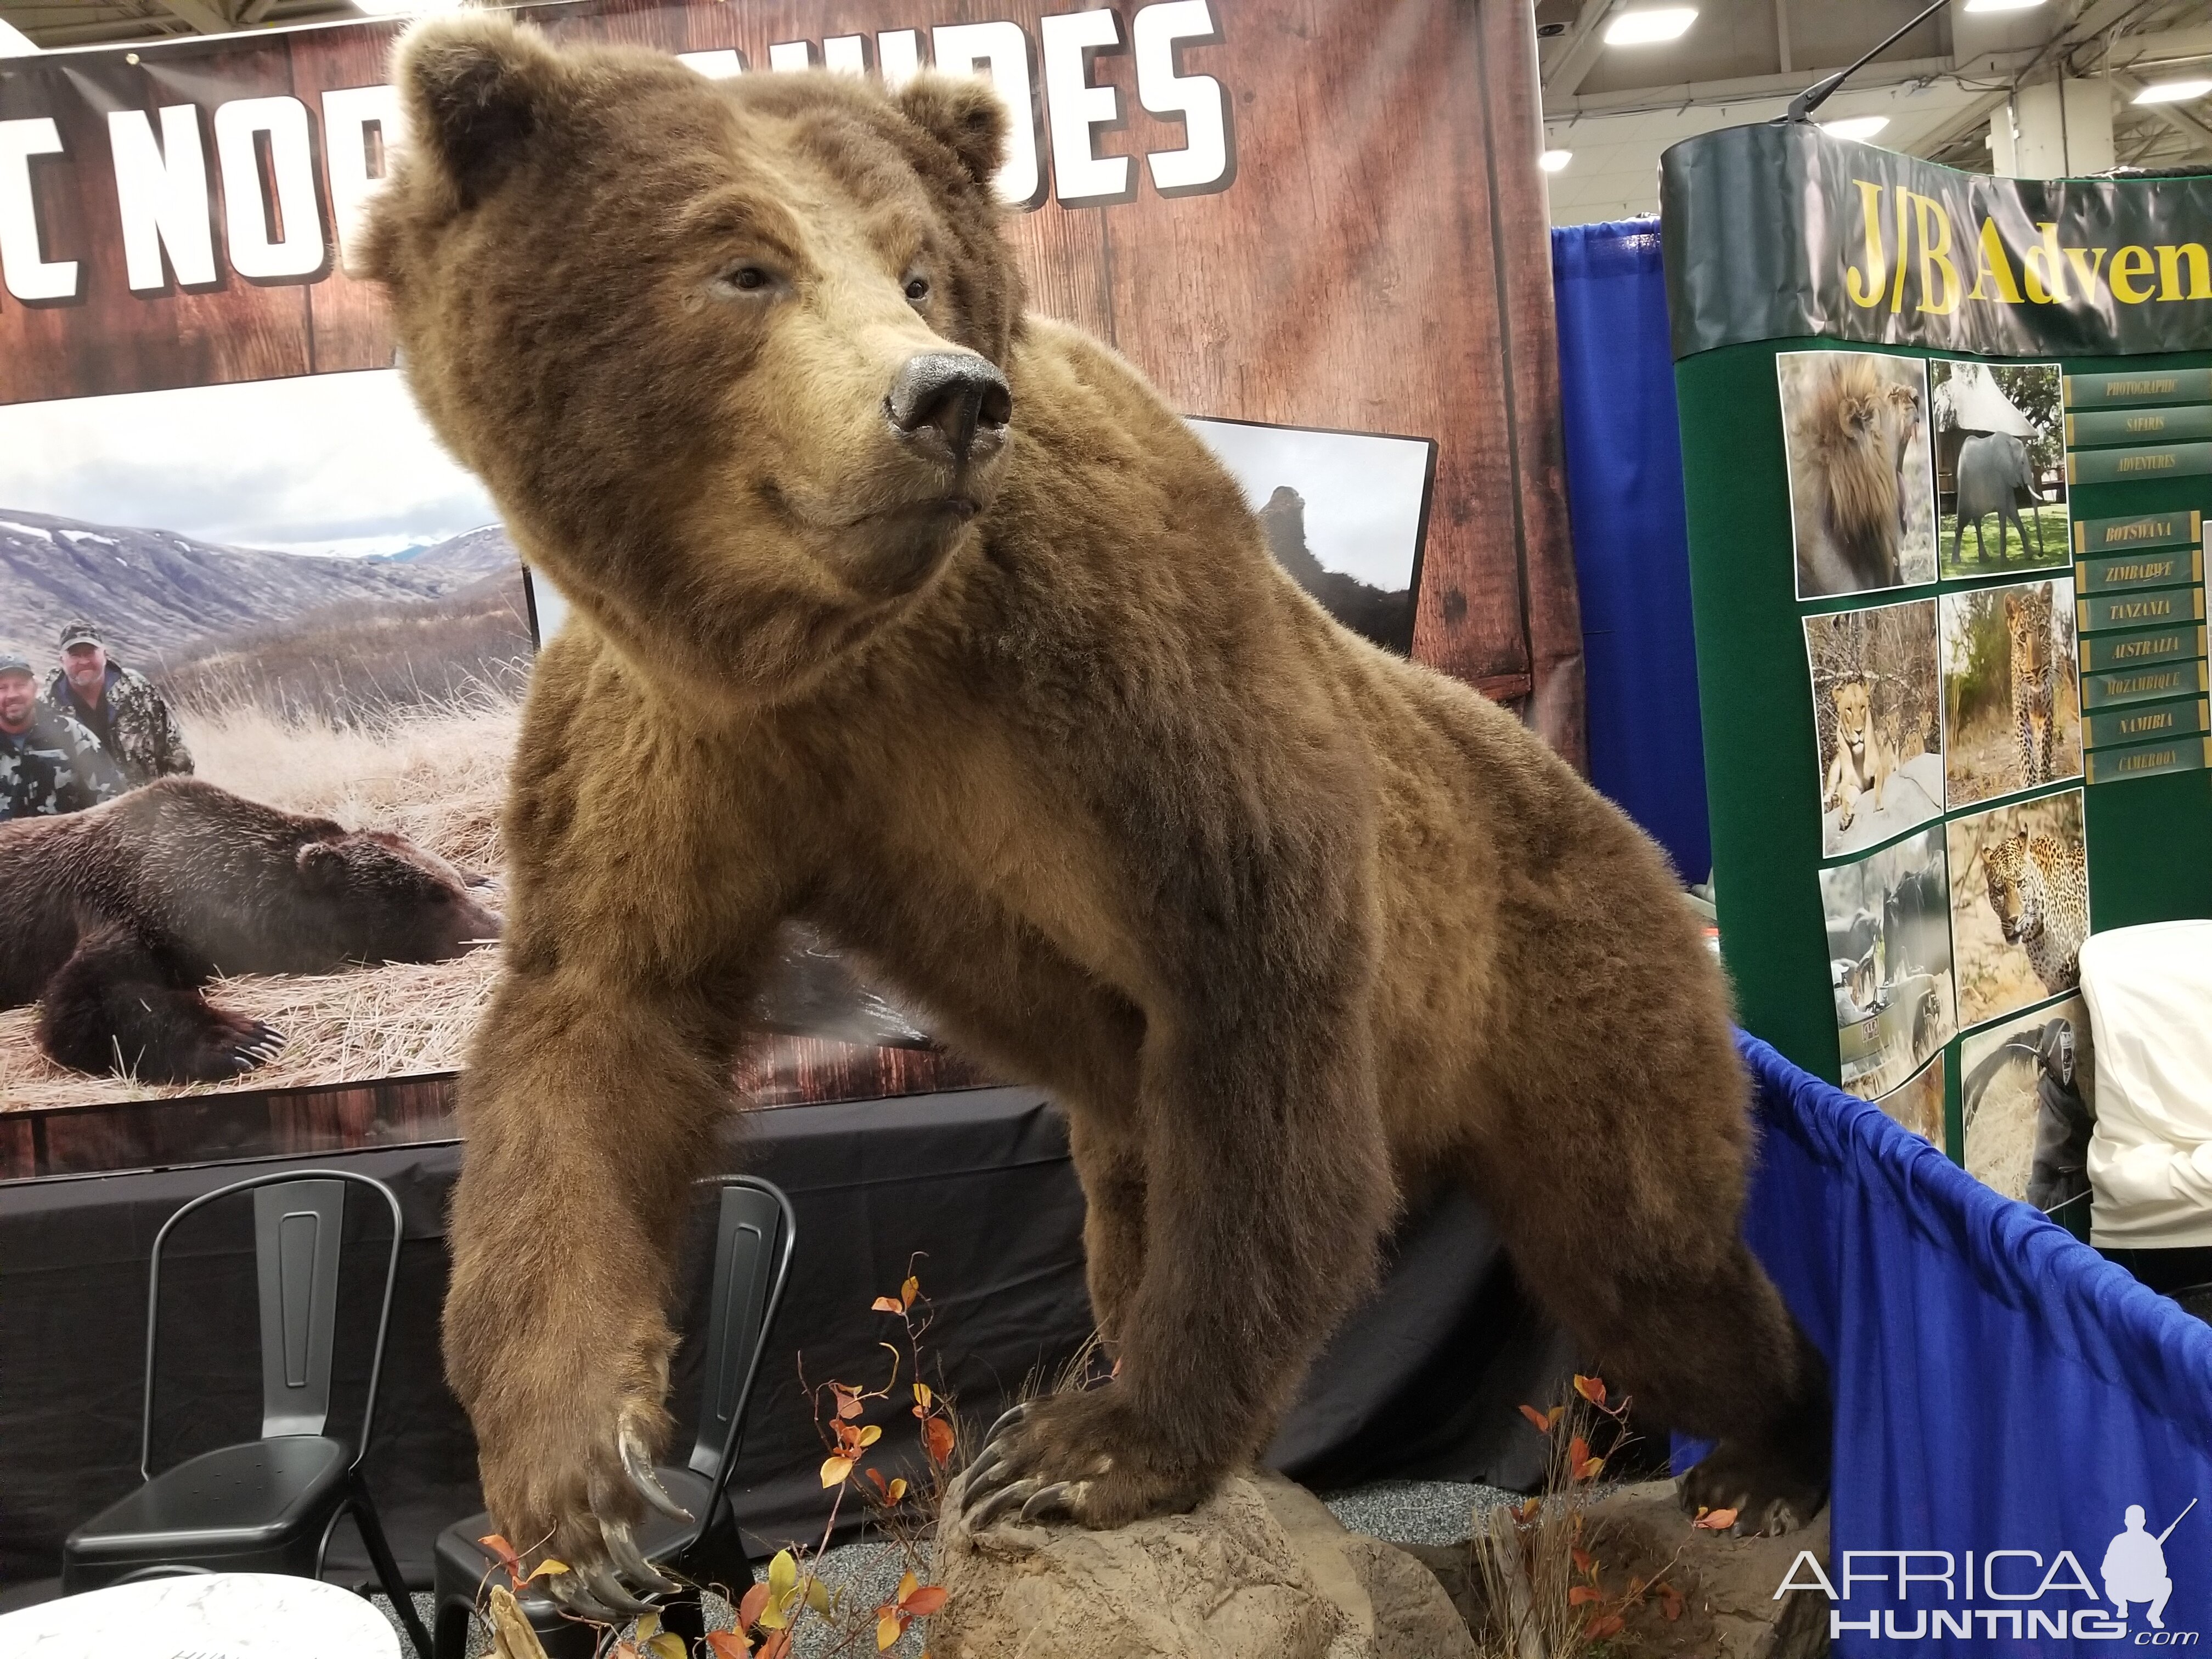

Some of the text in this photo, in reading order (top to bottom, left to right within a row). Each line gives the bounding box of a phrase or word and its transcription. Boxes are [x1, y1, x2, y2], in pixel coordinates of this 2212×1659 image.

[1847, 179, 2212, 315] J/B Adven
[2106, 379, 2178, 396] PHOTOGRAPHIC
[2126, 416, 2165, 432] SAFARIS
[2117, 454, 2176, 472] ADVENTURES
[2106, 522, 2171, 542] BOTSWANA
[2106, 561, 2173, 582] ZIMBABWE
[2110, 600, 2170, 620] TANZANIA
[2112, 636, 2179, 659] AUSTRALIA
[2106, 672, 2180, 696] MOZAMBIQUE
[2119, 713, 2172, 733] NAMIBIA
[2118, 750, 2176, 772] CAMEROON
